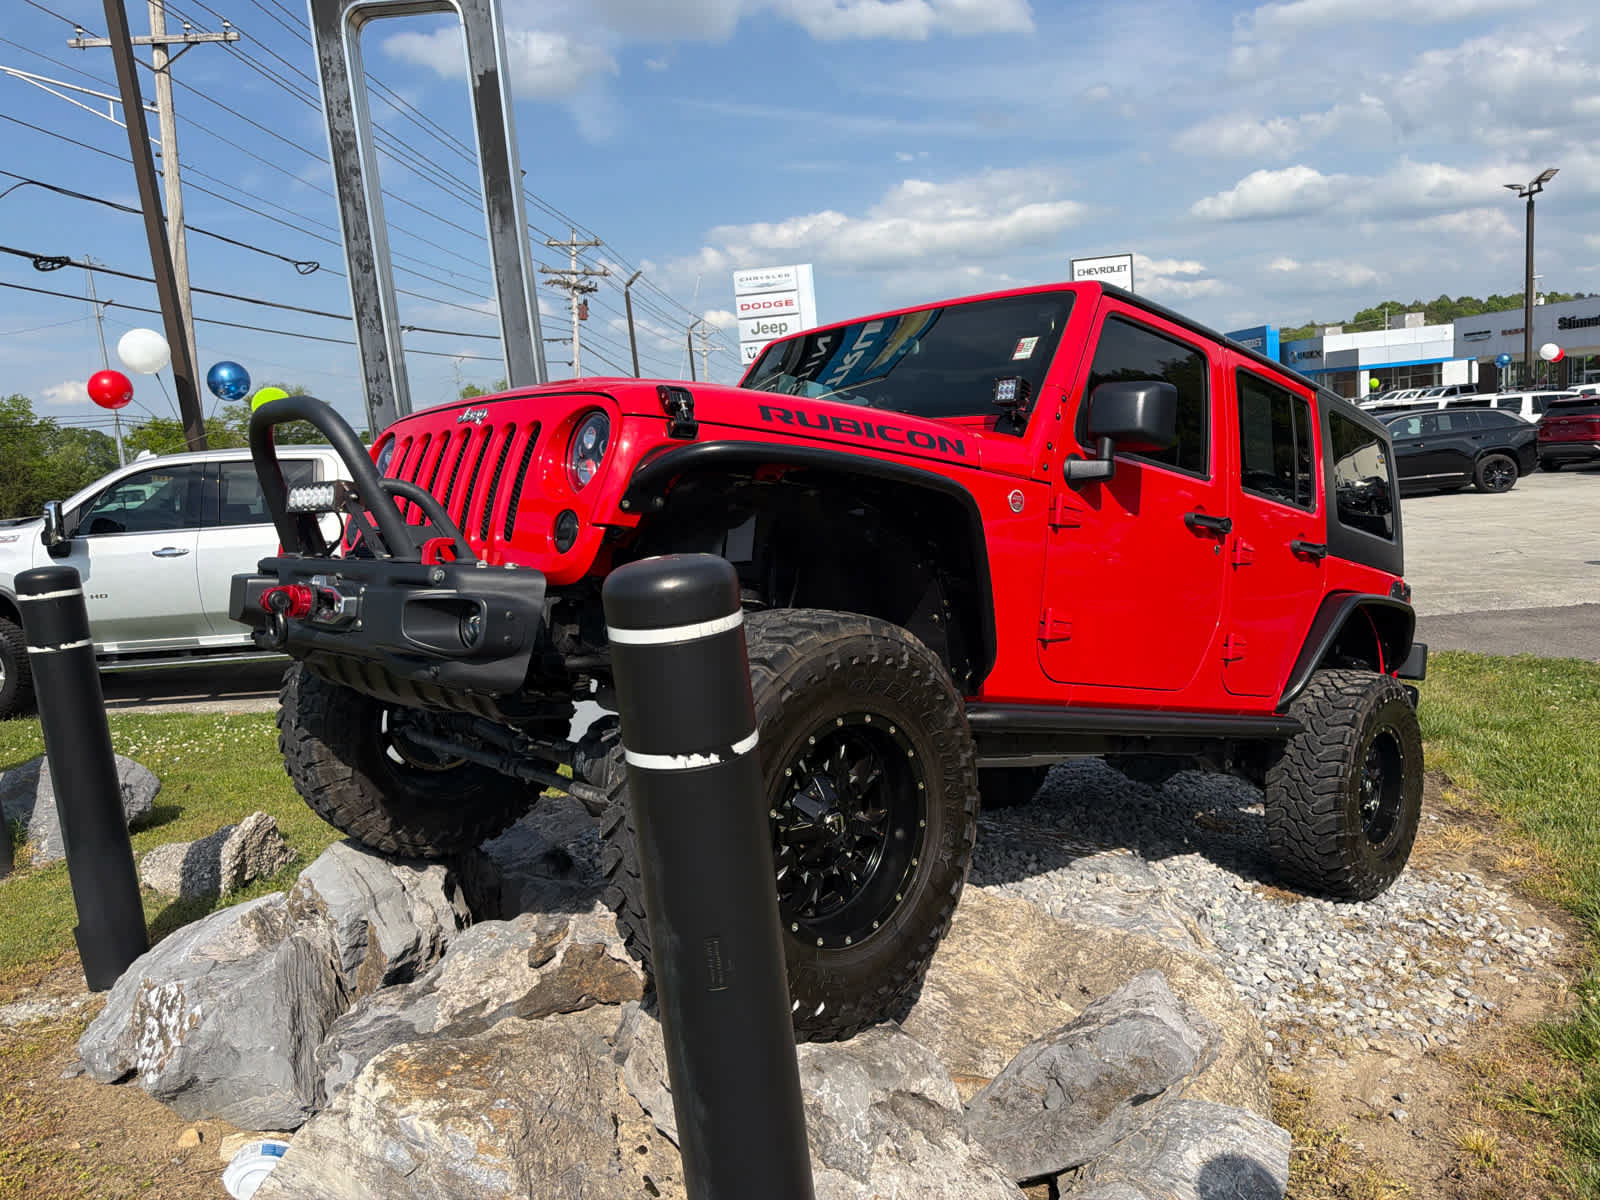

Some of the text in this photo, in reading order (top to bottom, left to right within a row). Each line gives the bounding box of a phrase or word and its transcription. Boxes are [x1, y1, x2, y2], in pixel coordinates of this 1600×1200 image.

[1077, 264, 1128, 276] CHEVROLET
[740, 299, 794, 311] DODGE
[751, 320, 788, 335] Jeep
[457, 407, 488, 424] Jeep
[758, 404, 966, 457] RUBICON
